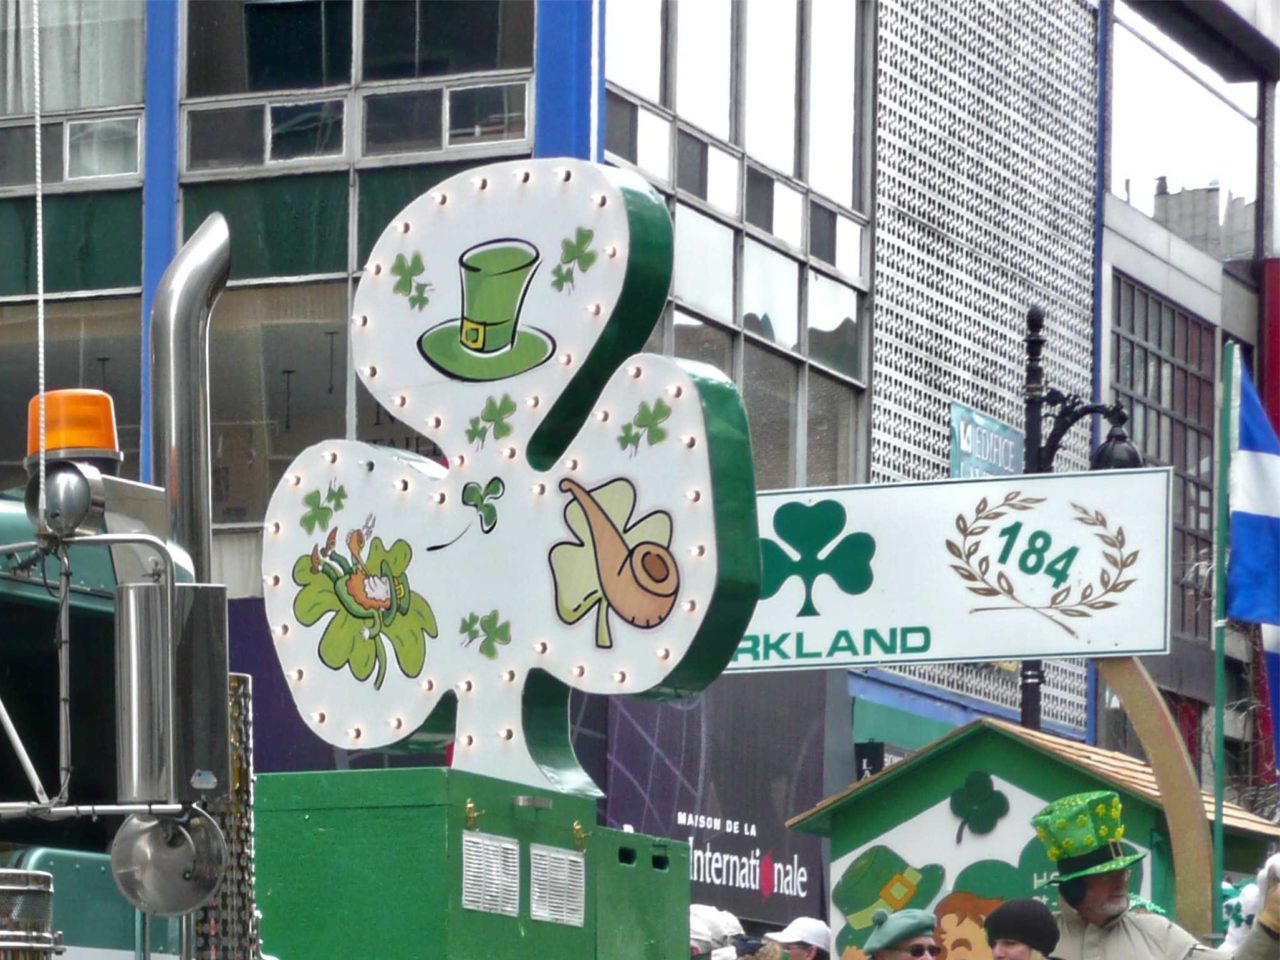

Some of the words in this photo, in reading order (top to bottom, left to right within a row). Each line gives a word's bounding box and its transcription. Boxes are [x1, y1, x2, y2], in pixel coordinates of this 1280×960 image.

[997, 520, 1080, 590] 184
[677, 811, 721, 831] MAISON
[725, 820, 740, 834] DE
[744, 823, 757, 837] LA
[688, 836, 808, 899] Internationale
